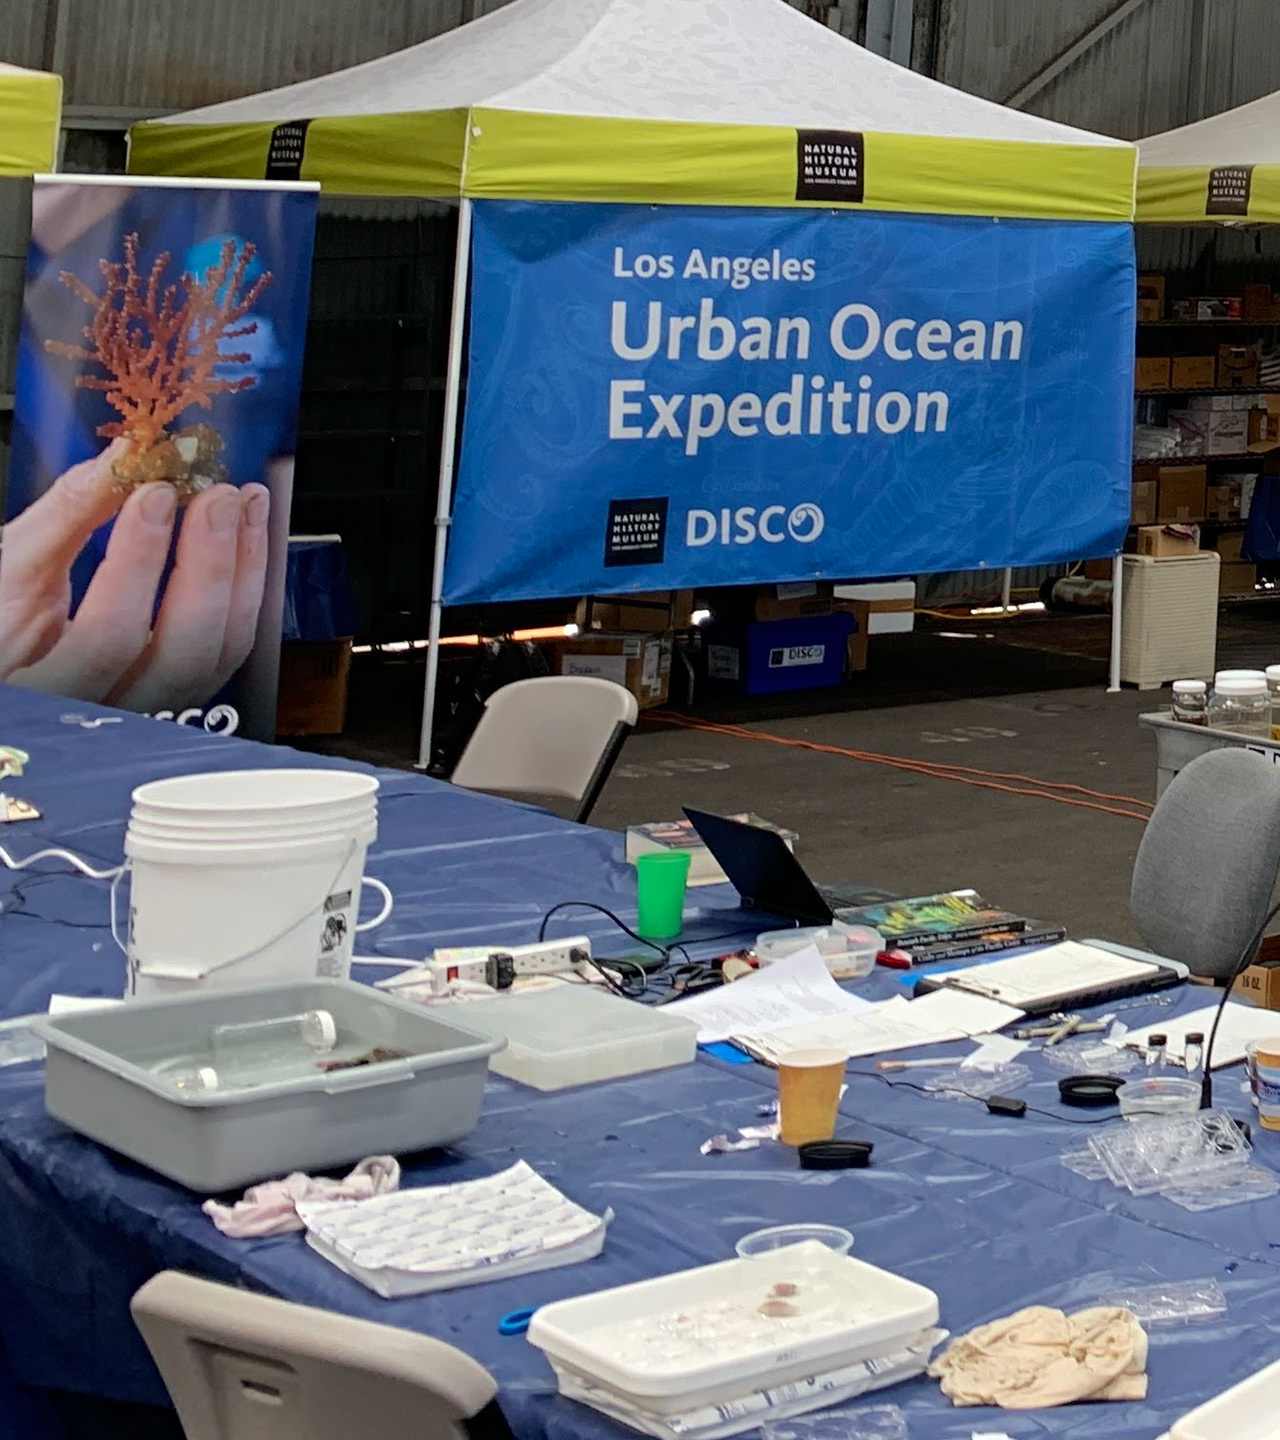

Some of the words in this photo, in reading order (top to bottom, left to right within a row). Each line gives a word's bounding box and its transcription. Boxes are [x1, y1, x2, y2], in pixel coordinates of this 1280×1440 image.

[804, 144, 857, 156] NATURAL
[804, 155, 857, 166] HISTORY
[804, 166, 857, 178] MUSEUM
[613, 247, 674, 280] Los
[683, 248, 816, 290] Angeles
[610, 299, 809, 361] Urban
[831, 304, 1024, 363] Ocean
[608, 376, 949, 455] Expedition
[614, 512, 661, 524] NATURAL
[613, 522, 661, 534] HISTORY
[686, 502, 825, 547] DISCO
[612, 533, 660, 544] MUSEUM
